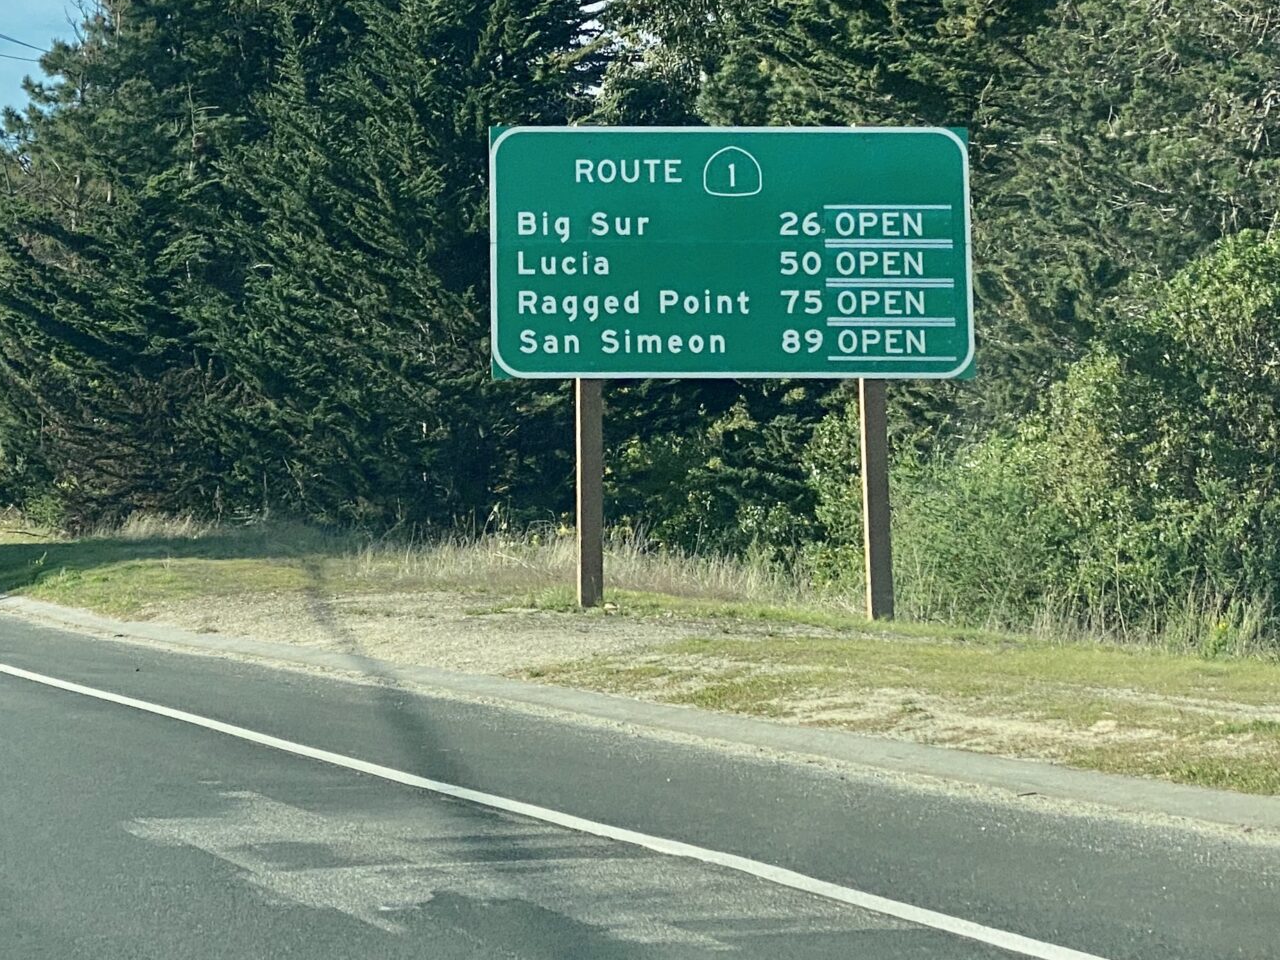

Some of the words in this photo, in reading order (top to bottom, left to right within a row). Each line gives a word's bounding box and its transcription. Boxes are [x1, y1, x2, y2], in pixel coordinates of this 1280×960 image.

[576, 160, 682, 182] ROUTE
[729, 164, 735, 186] 1
[518, 212, 569, 243] Big
[592, 212, 649, 235] Sur
[780, 212, 820, 235] 26
[836, 212, 922, 236] OPEN
[518, 251, 608, 274] Lucia
[781, 252, 821, 275] 50
[837, 252, 923, 275] OPEN
[519, 291, 639, 321] Ragged
[660, 290, 749, 314] Point
[781, 290, 822, 314] 75
[838, 291, 924, 314] OPEN
[520, 330, 579, 353] San
[602, 330, 725, 353] Simeon
[782, 329, 823, 353] 89
[838, 330, 925, 353] OPEN
